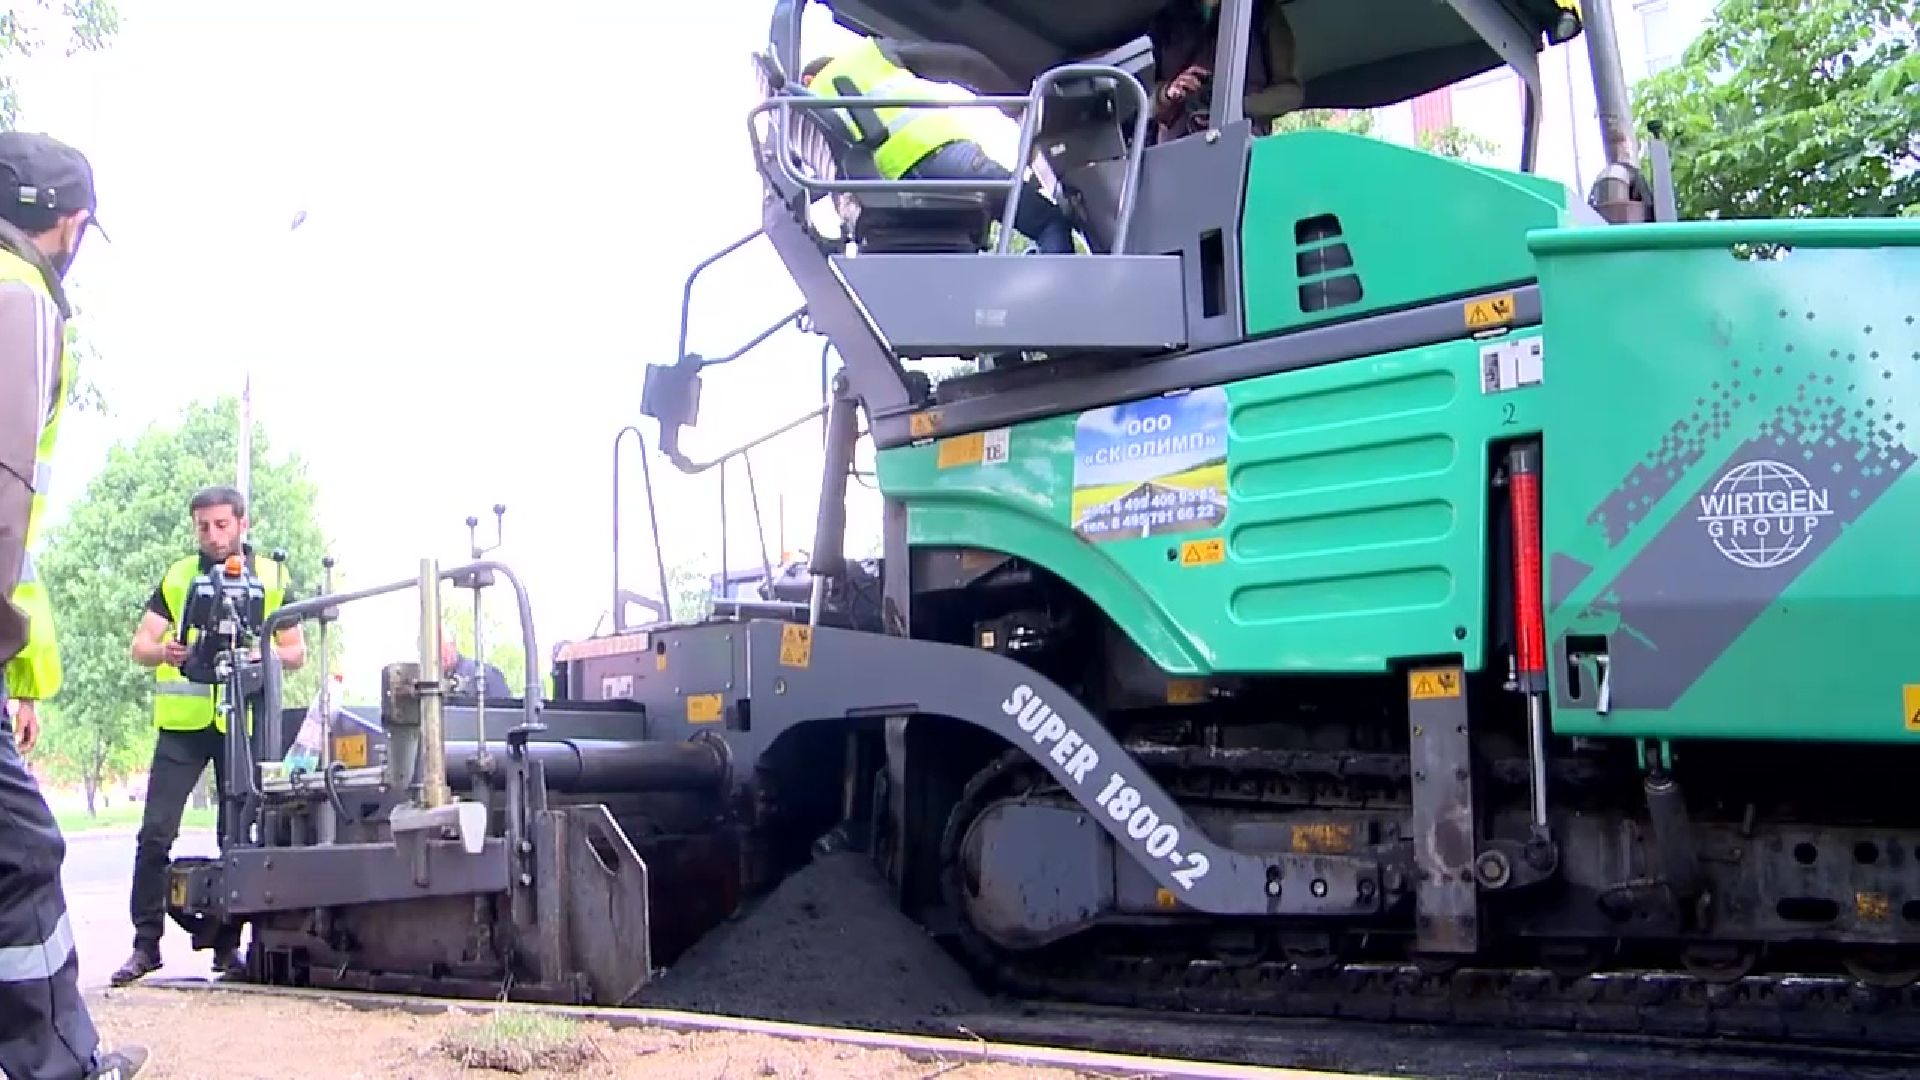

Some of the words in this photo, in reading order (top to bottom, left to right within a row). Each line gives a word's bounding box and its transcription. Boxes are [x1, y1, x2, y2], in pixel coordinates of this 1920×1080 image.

[1128, 414, 1171, 436] ООО
[1502, 402, 1519, 426] 2
[1083, 448, 1120, 466] «СК
[1127, 432, 1217, 458] ОЛИМП»
[1700, 488, 1828, 516] WIRTGEN
[1708, 516, 1819, 538] GROUP
[1002, 685, 1099, 785] SUPER
[1096, 772, 1210, 891] 1800-2
